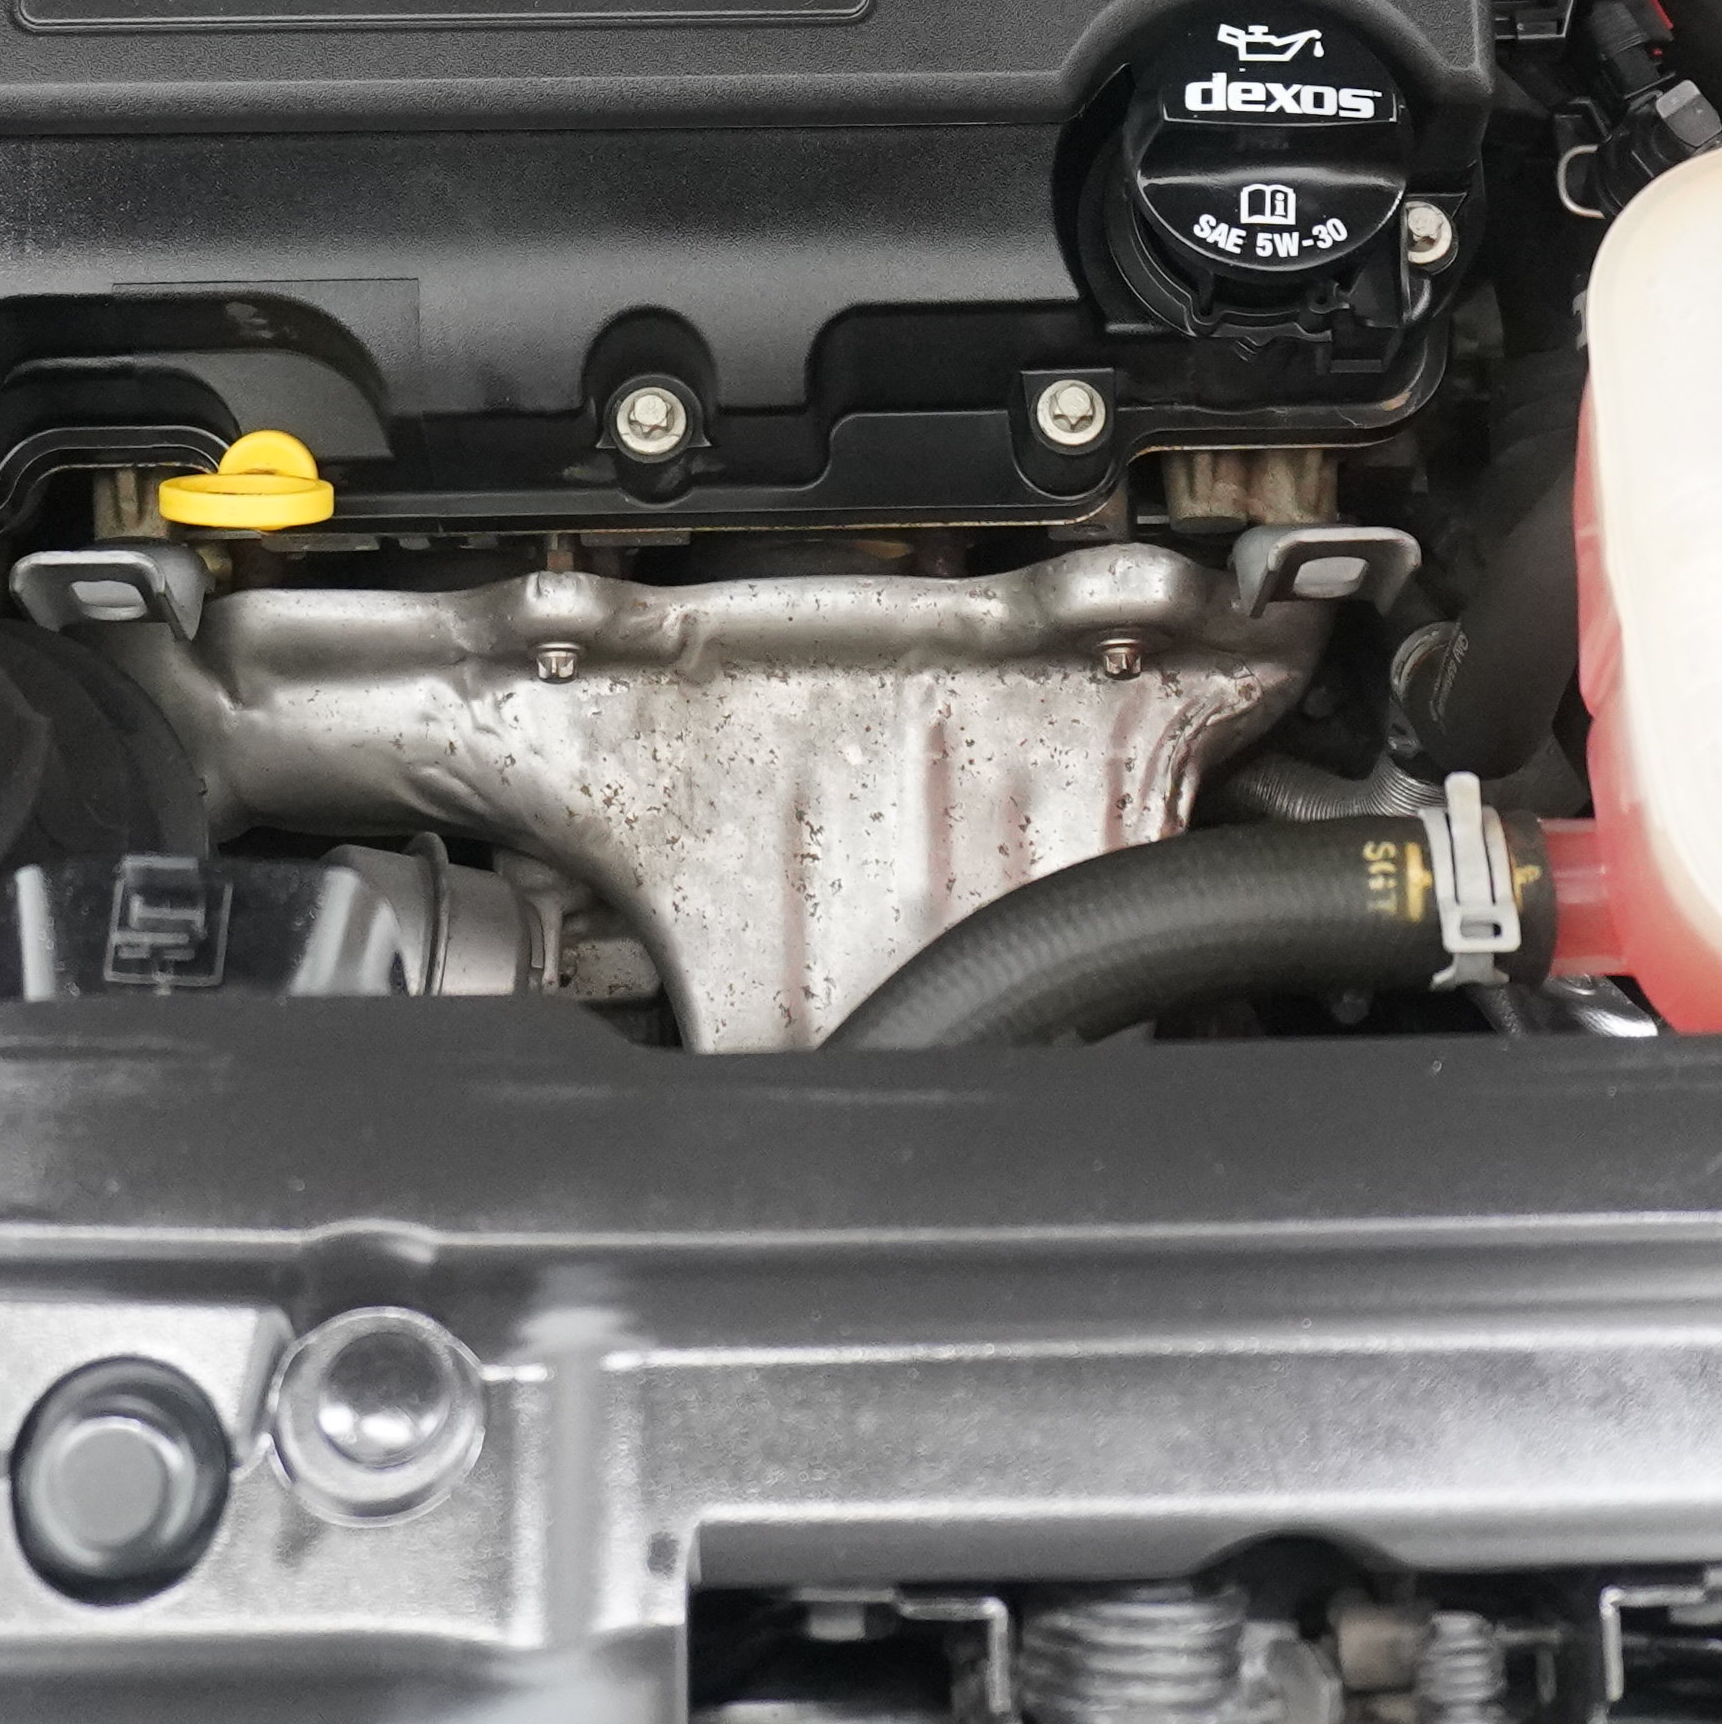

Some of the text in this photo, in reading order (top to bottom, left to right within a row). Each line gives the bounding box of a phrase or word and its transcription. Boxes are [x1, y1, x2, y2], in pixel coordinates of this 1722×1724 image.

[1184, 71, 1376, 120] dexos
[1192, 213, 1349, 258] SAE 5W-30
